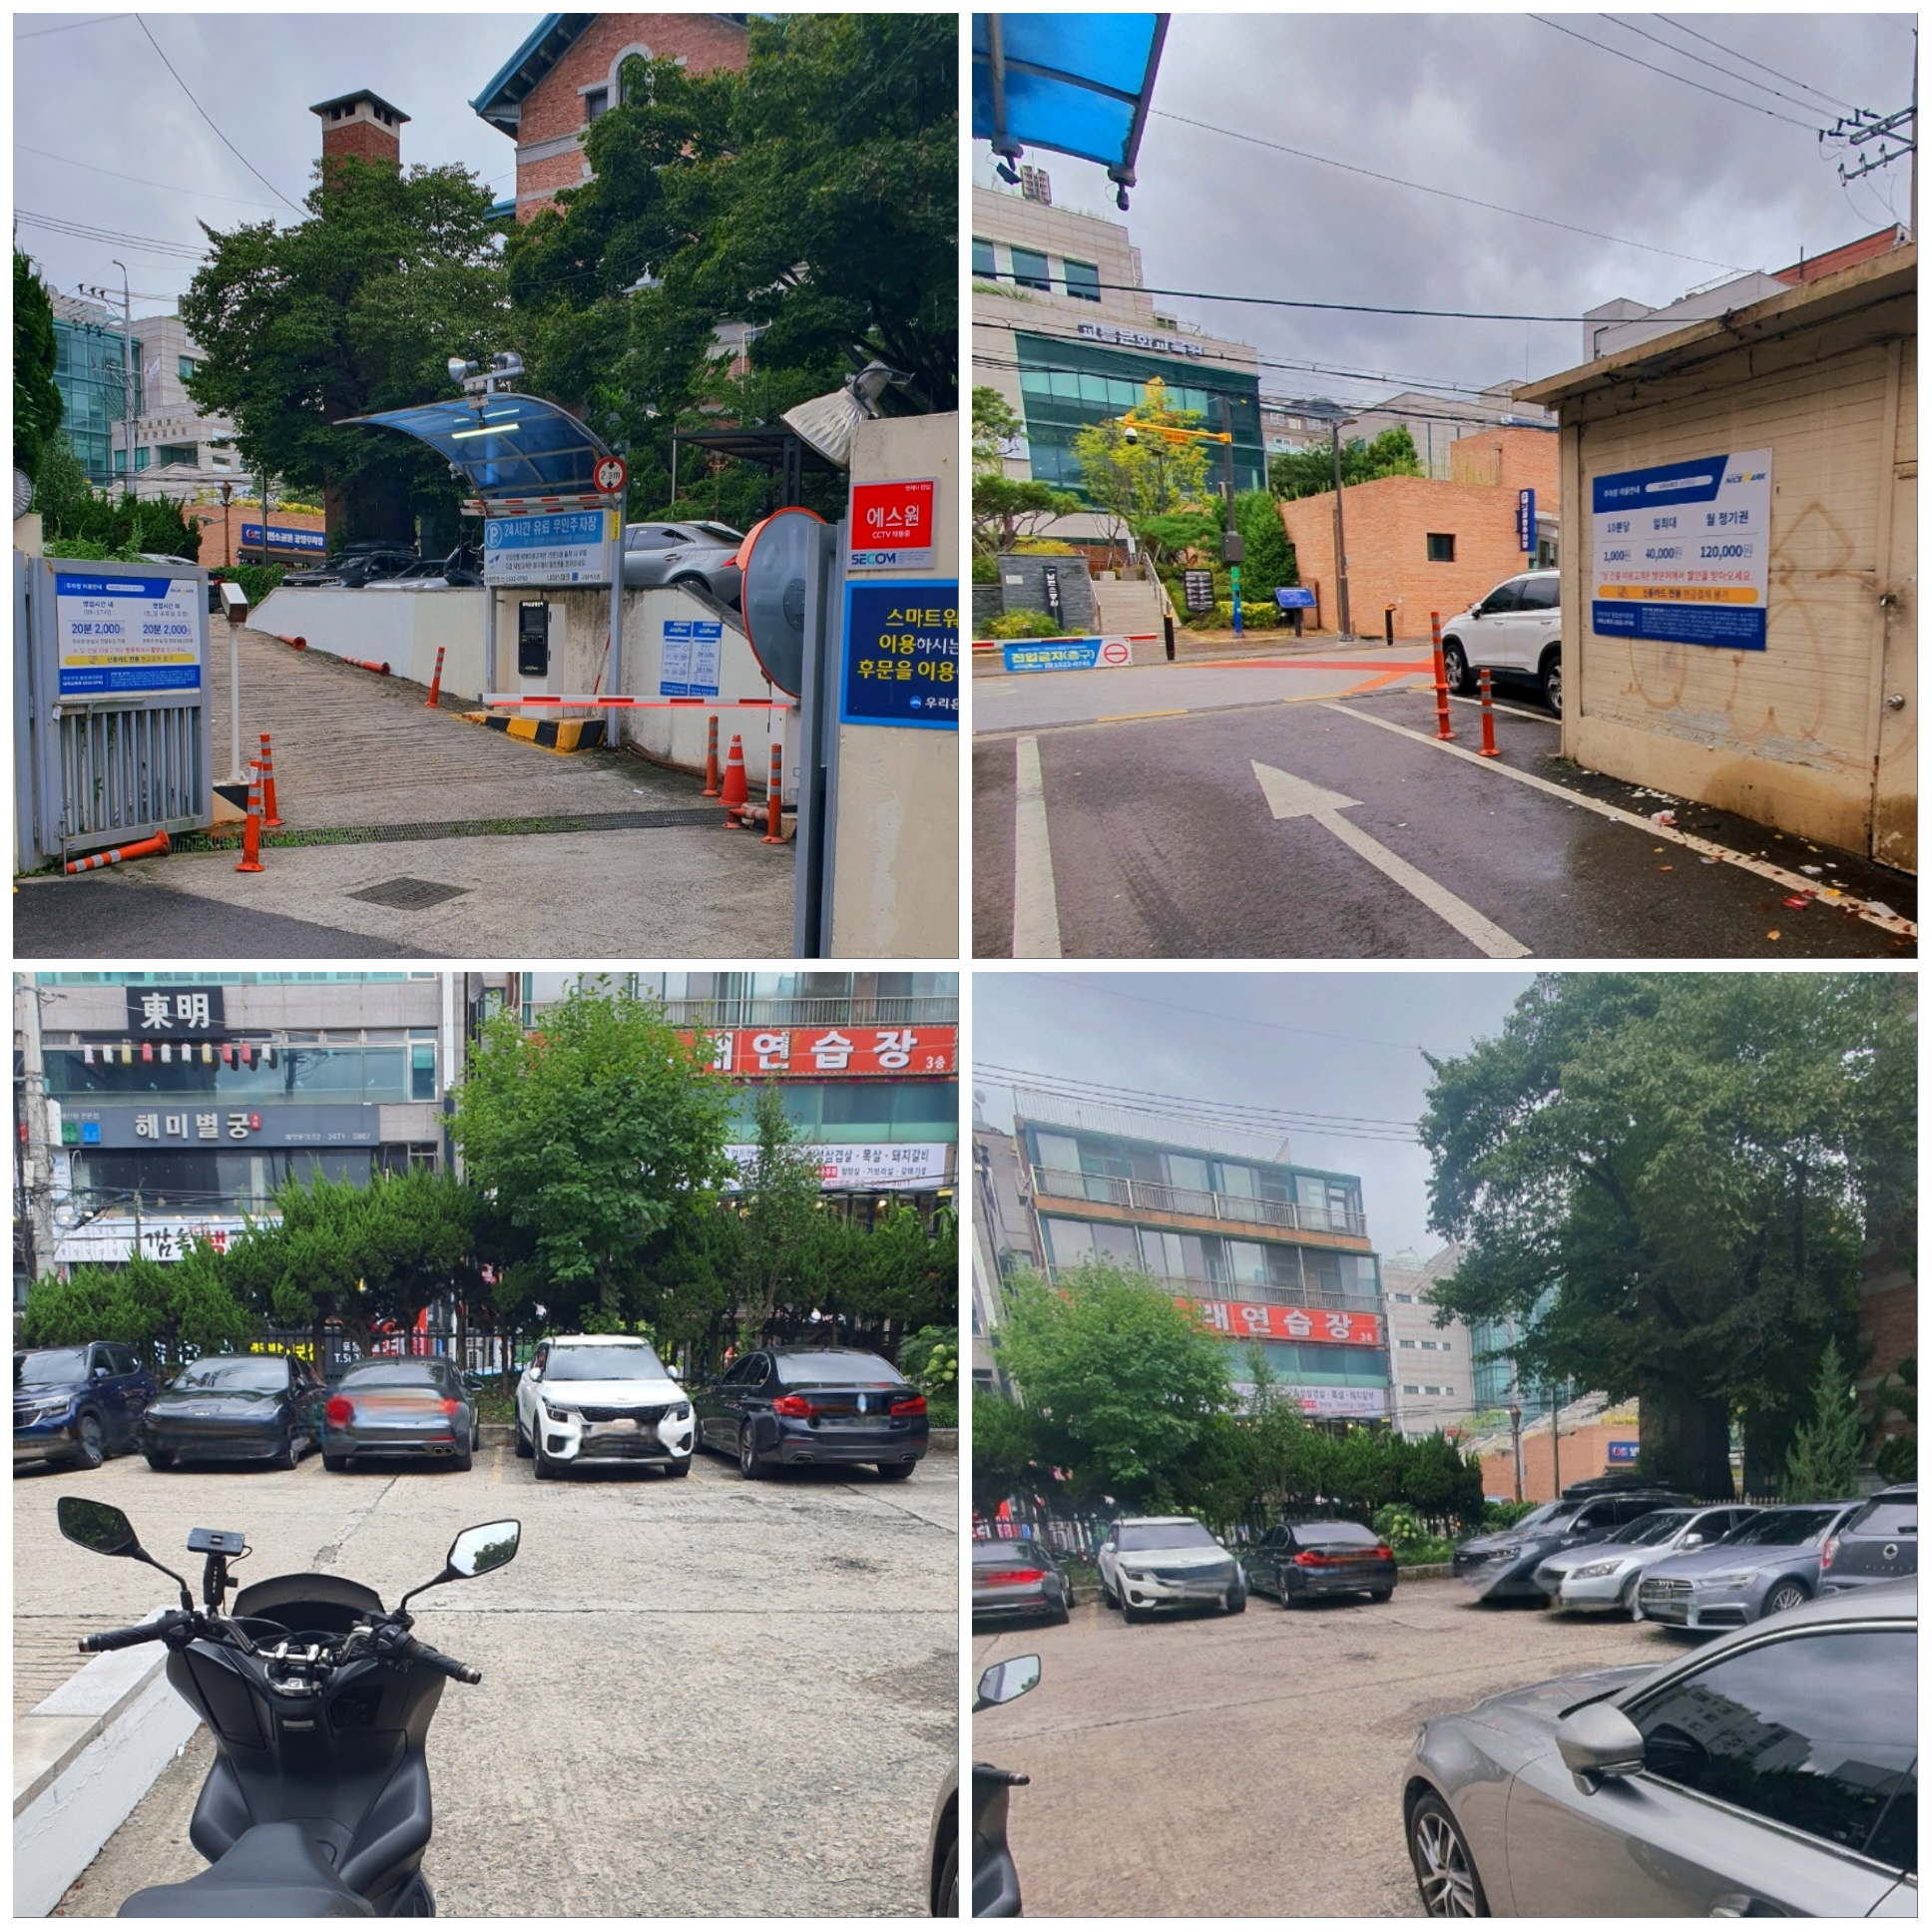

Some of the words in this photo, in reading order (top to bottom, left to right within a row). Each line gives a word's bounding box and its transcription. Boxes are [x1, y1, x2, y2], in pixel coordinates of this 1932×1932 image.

[1079, 322, 1203, 356] 교통문화교육원
[504, 522, 531, 537] 24시간
[534, 520, 550, 535] 유료
[553, 515, 597, 533] 무인주차장
[866, 505, 919, 528] 에스원
[1607, 522, 1630, 533] 10분당
[1653, 517, 1678, 531] 일최대
[1705, 513, 1715, 527] 월
[1718, 510, 1748, 526] 정기권
[851, 552, 896, 565] SECOM
[1604, 549, 1632, 563] 1,000원
[1646, 546, 1683, 561] 40,000원
[1699, 543, 1754, 560] 120,000원
[72, 624, 92, 635] 20분
[143, 625, 162, 635] 20분
[857, 659, 914, 681] 후문을
[141, 992, 211, 1029] 東明
[926, 1056, 946, 1069] 3층
[135, 1113, 249, 1140] 해미별궁
[862, 1149, 883, 1164] 목살
[891, 1148, 929, 1163] 돼지갈비
[866, 1167, 894, 1177] 가브리살
